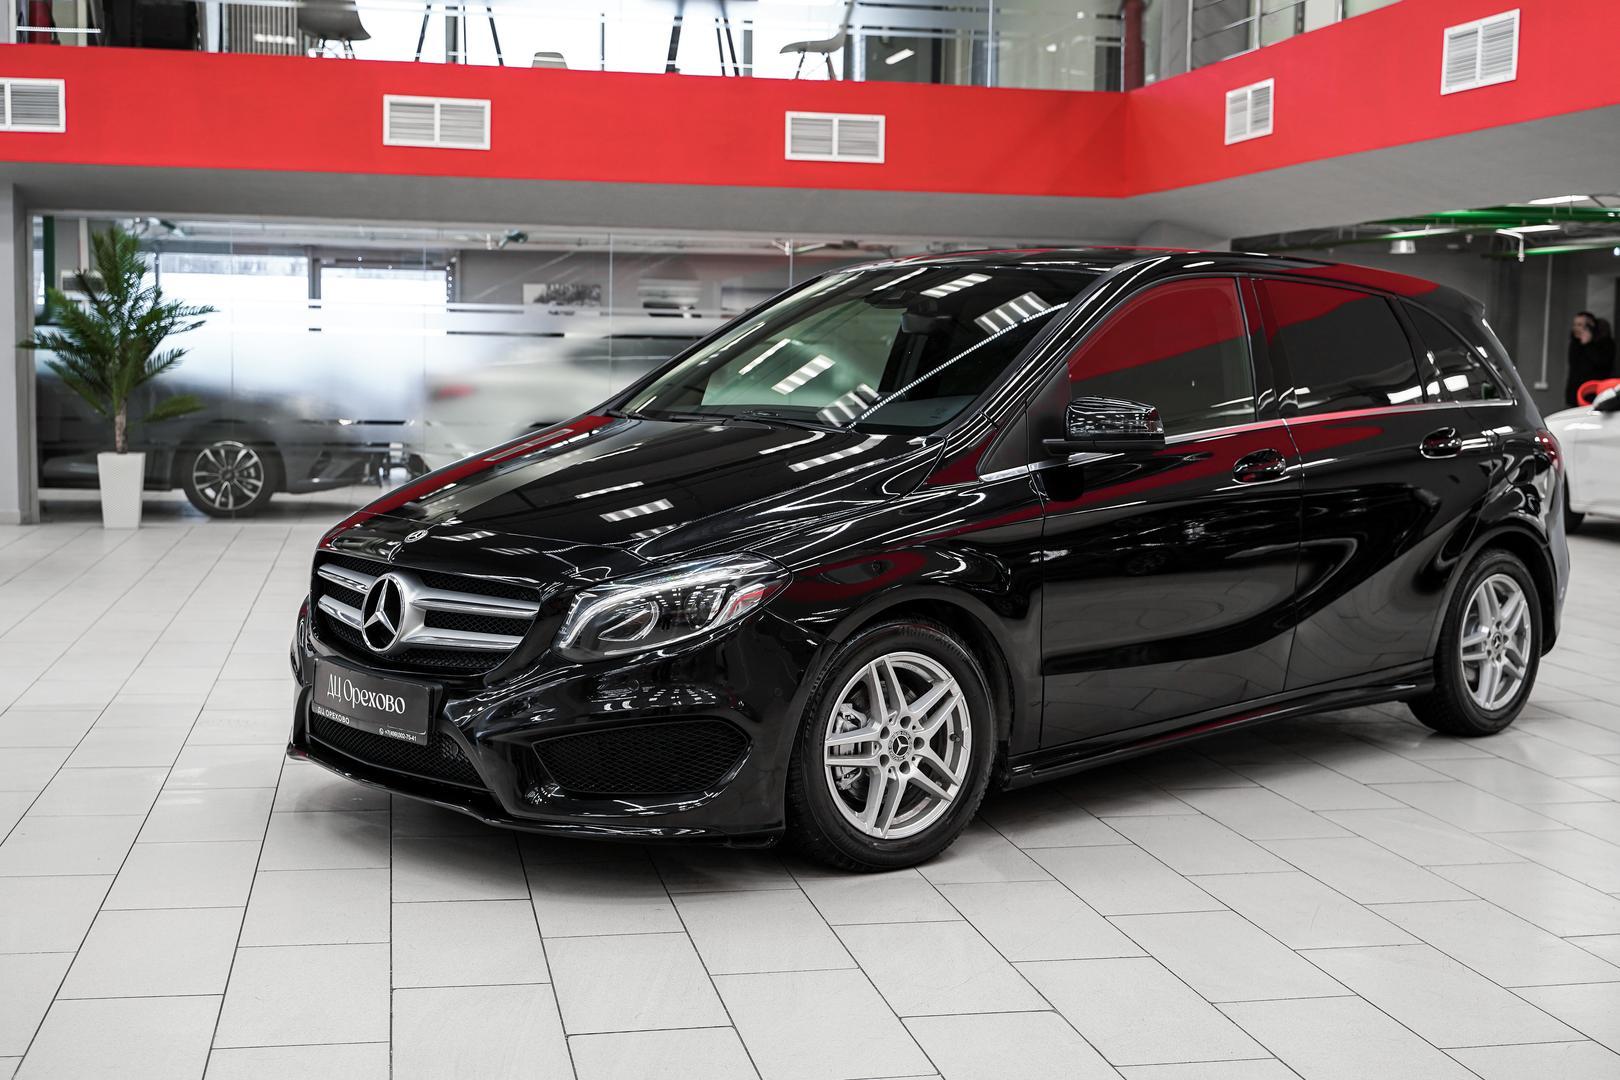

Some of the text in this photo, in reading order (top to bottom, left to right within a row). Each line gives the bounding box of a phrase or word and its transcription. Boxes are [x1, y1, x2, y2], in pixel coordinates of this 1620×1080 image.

[327, 674, 406, 714] ДЦ Орехово
[325, 709, 350, 725] ОРЕХОВО
